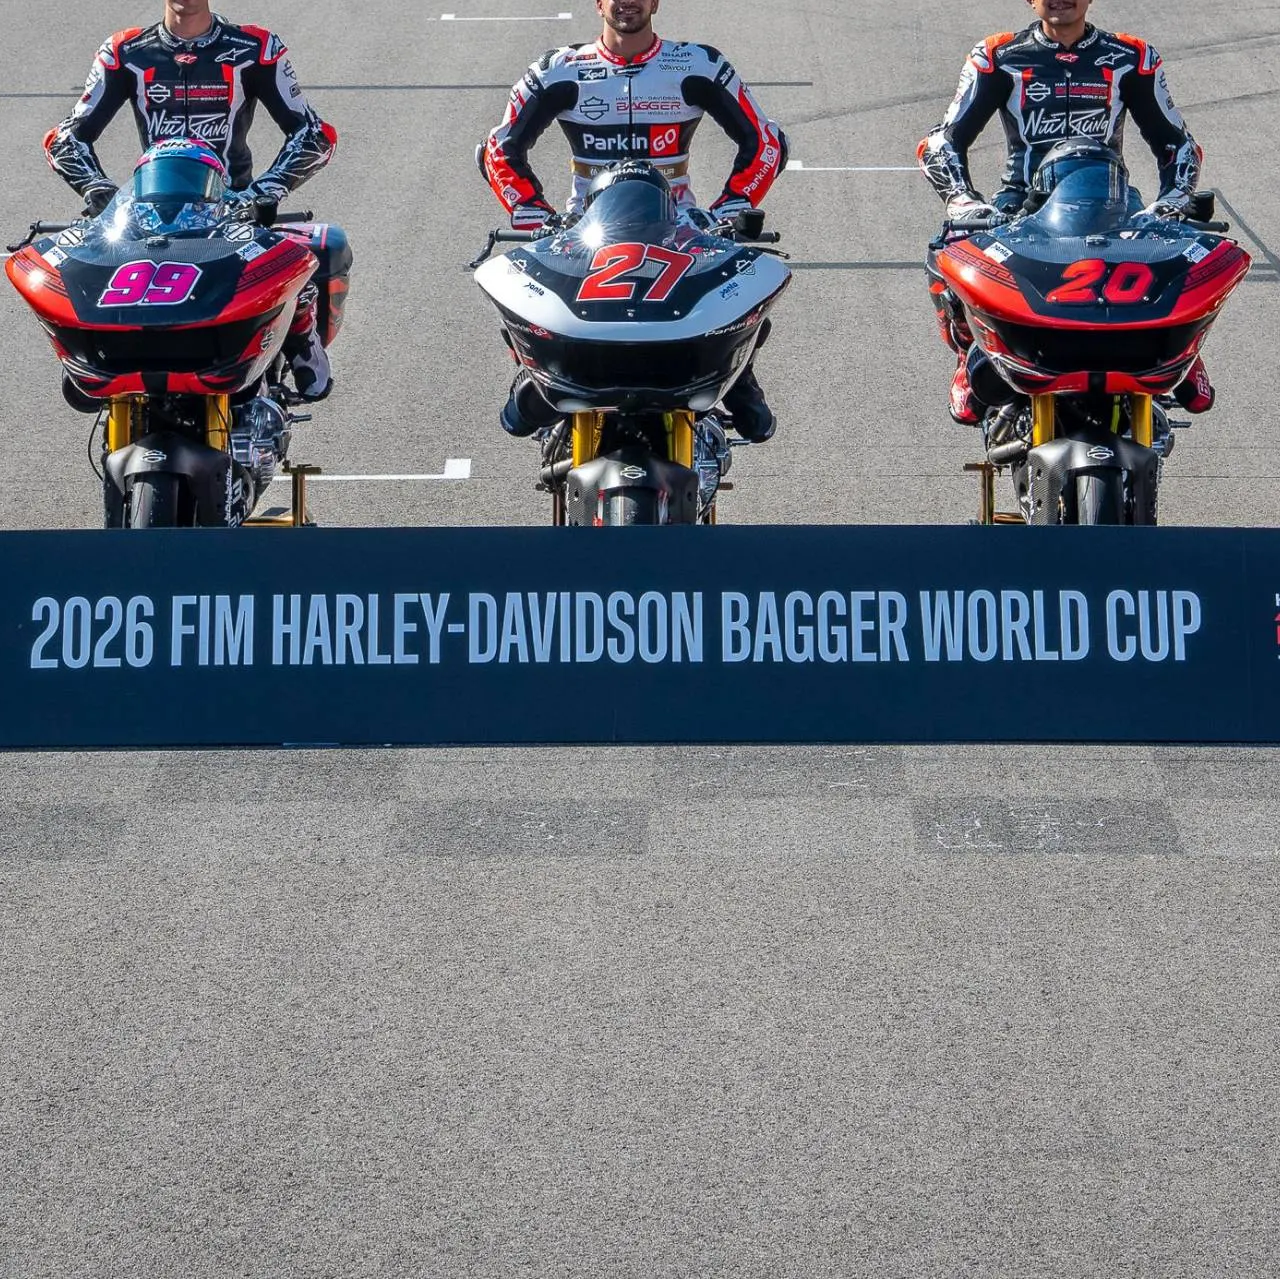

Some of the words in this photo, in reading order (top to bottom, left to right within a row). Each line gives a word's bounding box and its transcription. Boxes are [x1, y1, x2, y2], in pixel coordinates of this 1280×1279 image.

[583, 69, 606, 81] Xpd
[616, 101, 681, 111] BAGGER
[96, 259, 203, 307] 99
[575, 242, 696, 302] 27
[1045, 258, 1154, 304] 20
[30, 595, 155, 669] 2026
[171, 594, 255, 666] FIM
[272, 591, 704, 665] HARLEY-DAVIDSON
[721, 590, 910, 663] BAGGER
[920, 589, 1090, 662] WORLD
[1106, 588, 1203, 662] CUP
